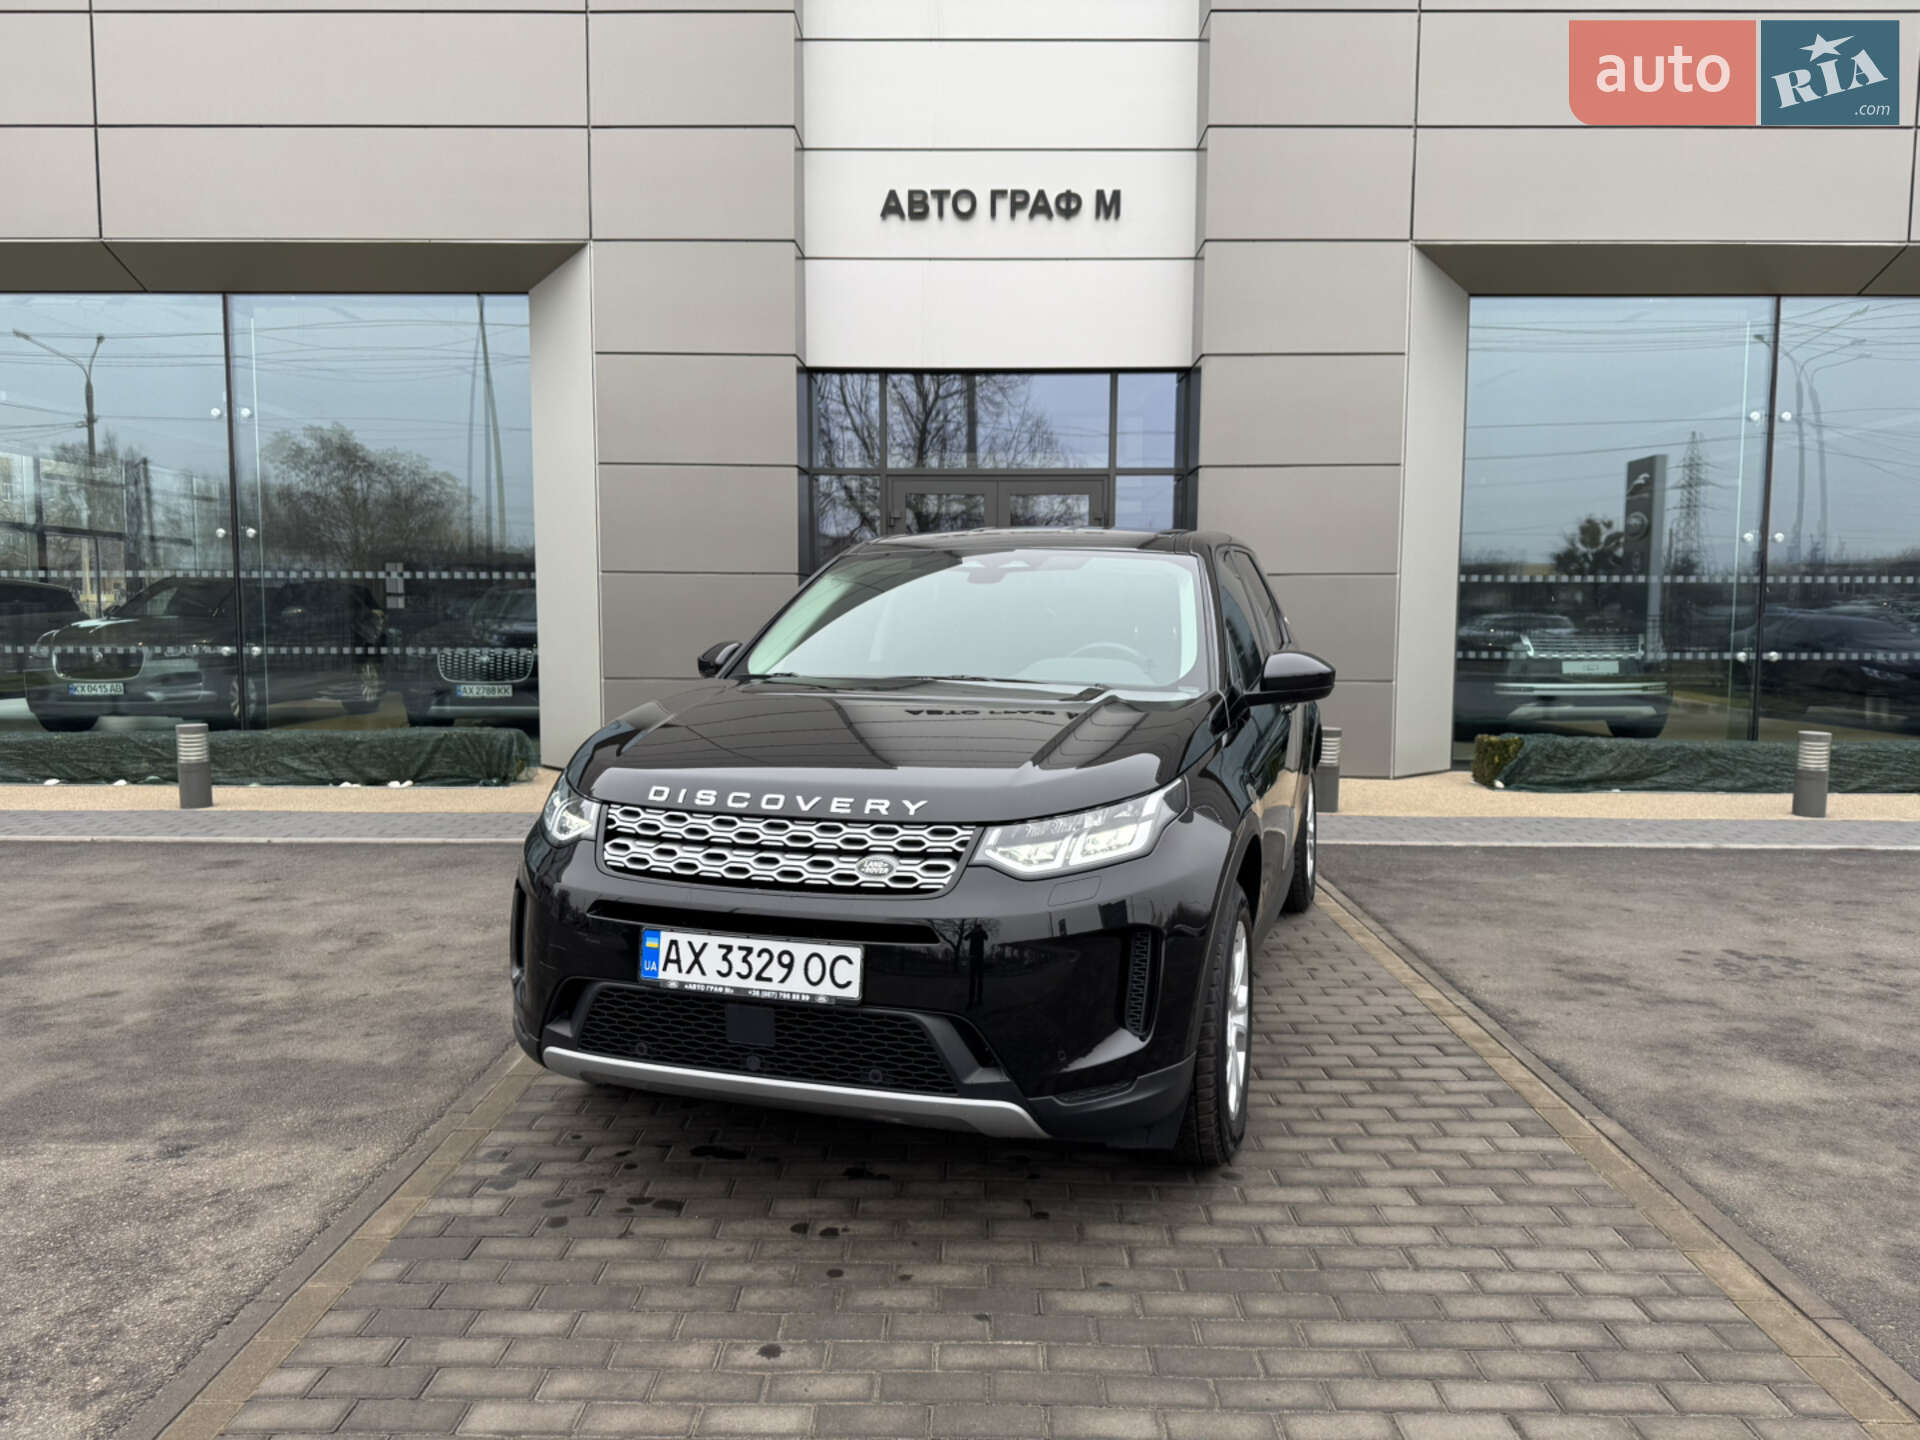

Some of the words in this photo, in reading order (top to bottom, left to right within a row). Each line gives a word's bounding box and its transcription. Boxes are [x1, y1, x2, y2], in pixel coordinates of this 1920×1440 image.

[880, 189, 977, 221] АВТО
[990, 189, 1083, 221] ГРАФ
[1095, 189, 1121, 221] М
[648, 785, 929, 816] DISCOVERY
[644, 960, 657, 972] UA
[662, 939, 708, 976] AX
[716, 944, 795, 984] 3329
[804, 952, 854, 989] OC
